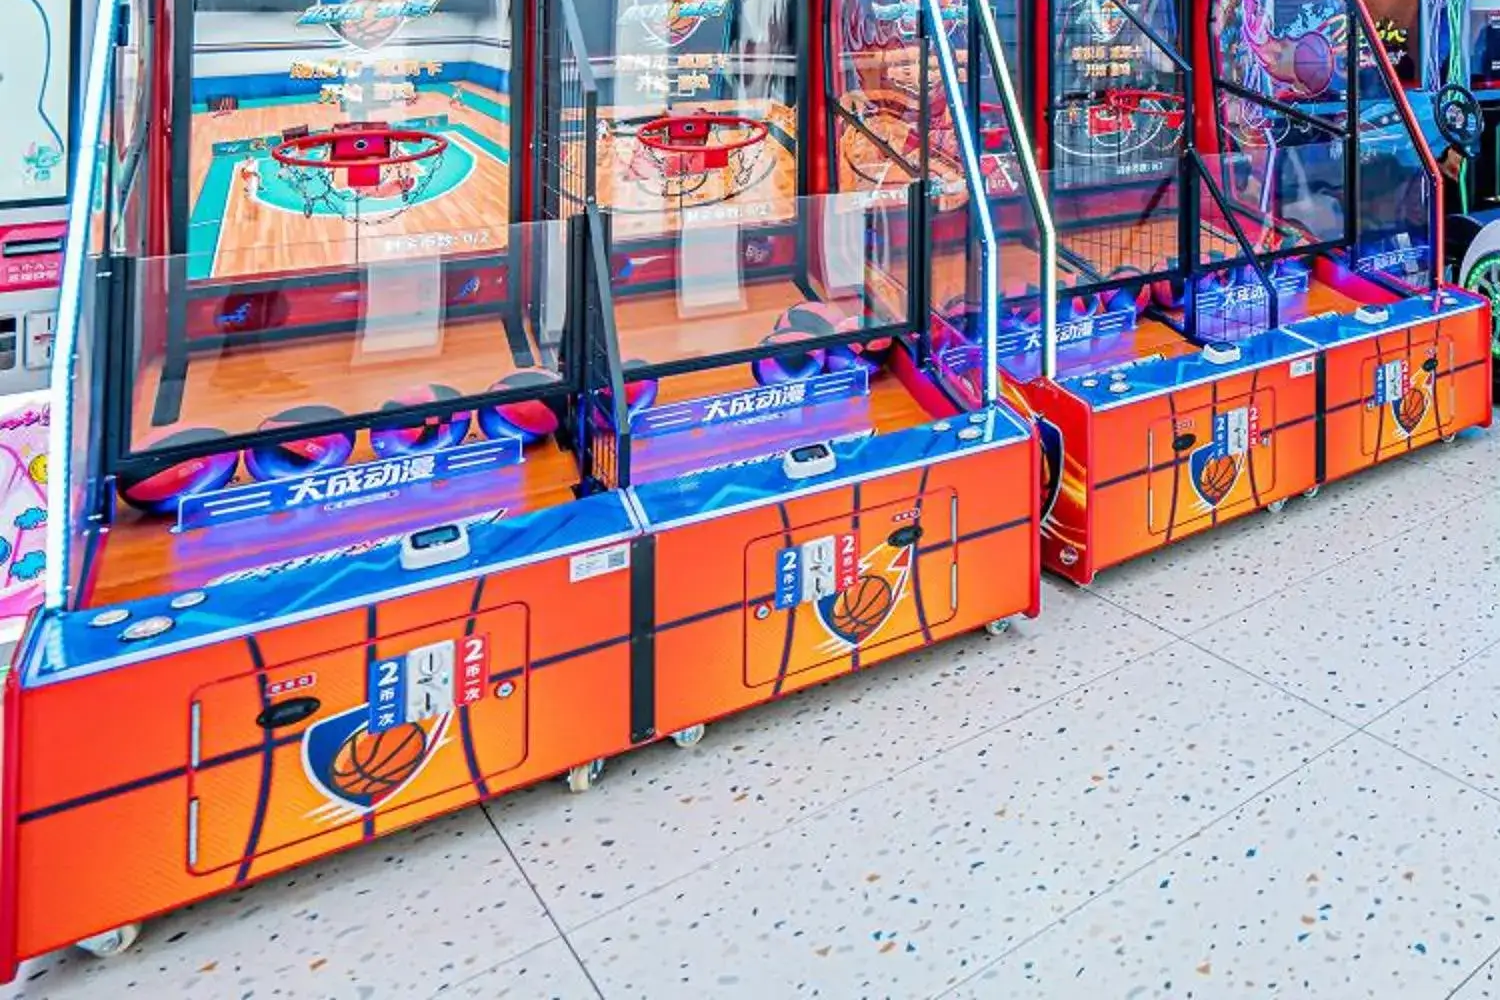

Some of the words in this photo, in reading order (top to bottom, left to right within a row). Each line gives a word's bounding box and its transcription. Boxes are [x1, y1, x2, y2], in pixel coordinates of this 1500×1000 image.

[702, 383, 806, 422] 大成动漫
[286, 454, 436, 505] 大成动漫
[377, 661, 399, 727] 2币一次
[464, 638, 484, 700] 2币一次
